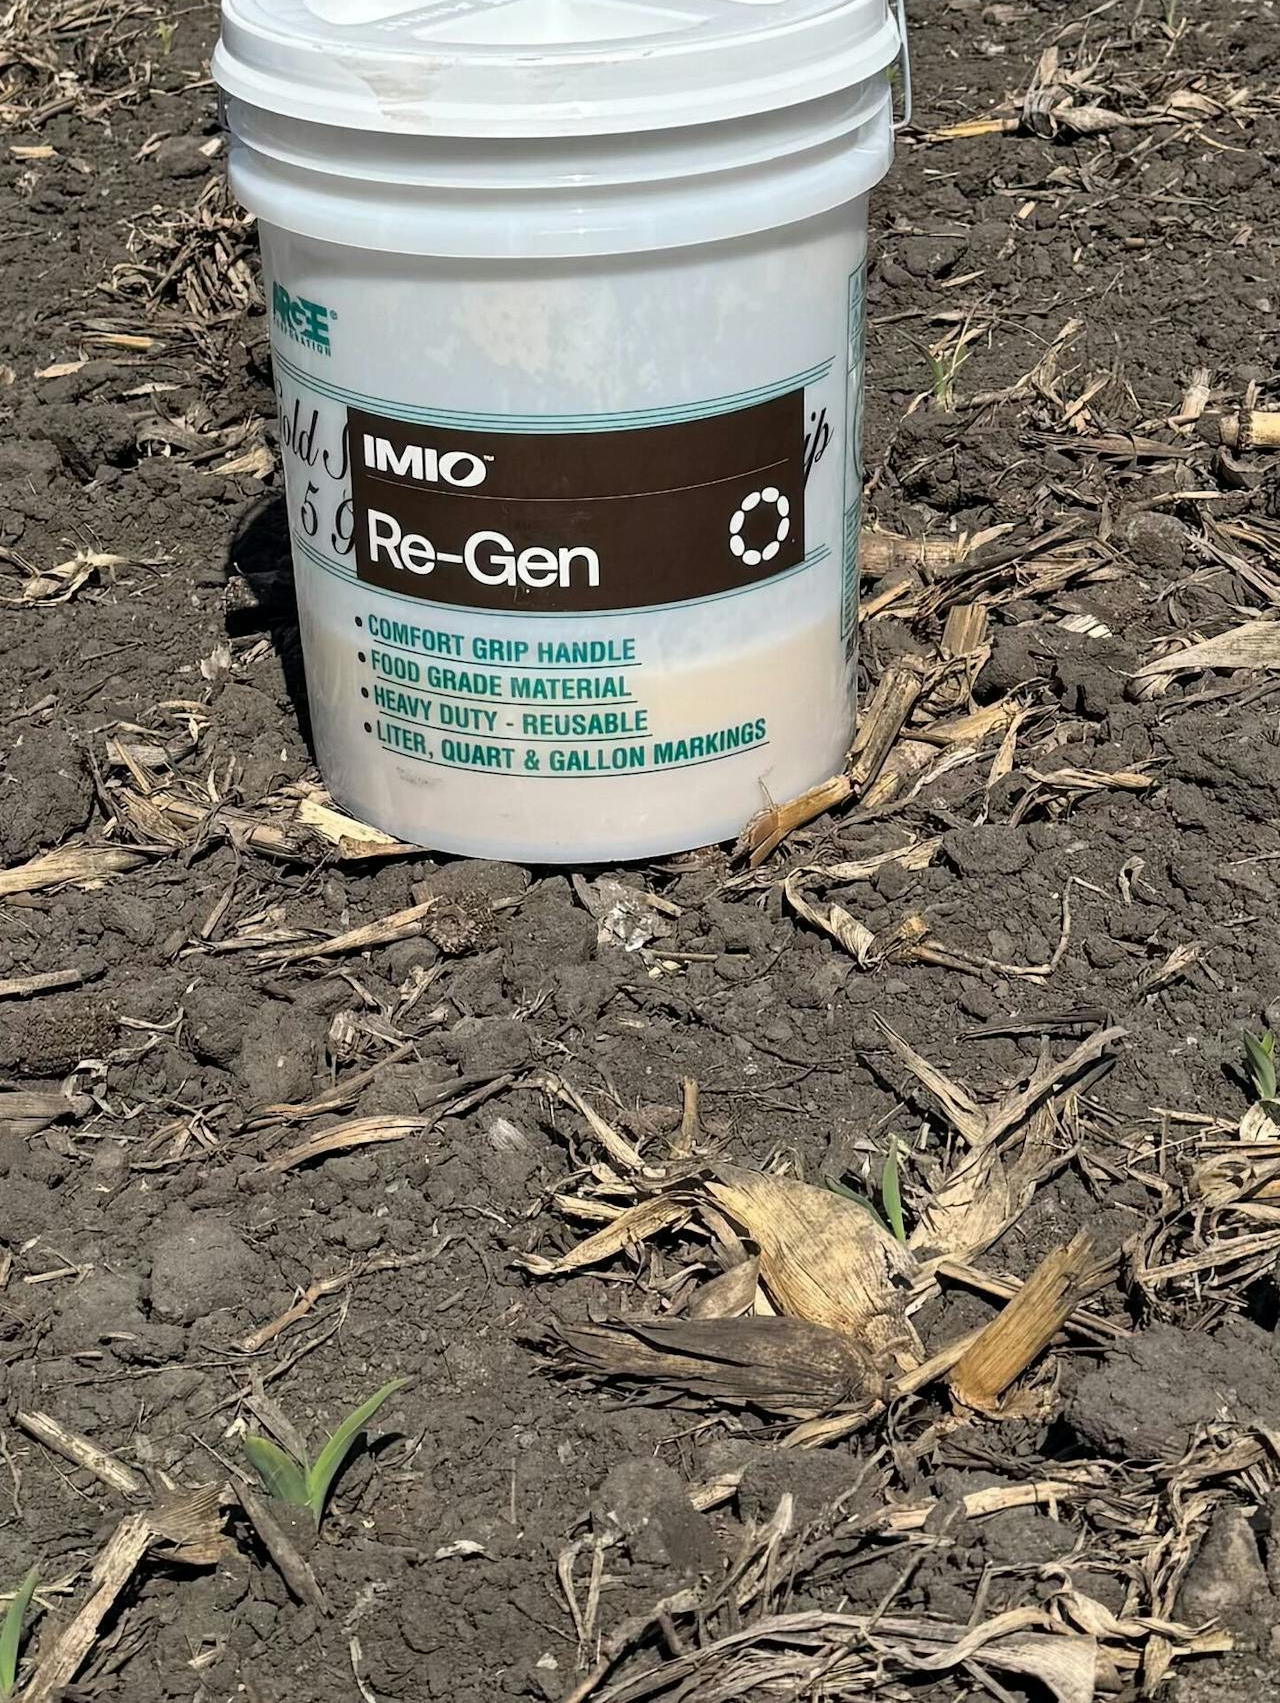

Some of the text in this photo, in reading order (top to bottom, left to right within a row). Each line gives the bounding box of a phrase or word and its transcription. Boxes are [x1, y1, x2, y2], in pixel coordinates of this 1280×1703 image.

[367, 508, 601, 588] Re-Gen
[367, 613, 636, 664] COMFORT GRIP HANDLE
[370, 649, 632, 700] FOOD GRADE MATERIAL
[373, 684, 433, 722] HEAVY
[439, 703, 498, 732] DUTY
[522, 709, 648, 736] REUSABLE
[376, 717, 767, 772] LITER, QUART & GALLON MARKINGS
